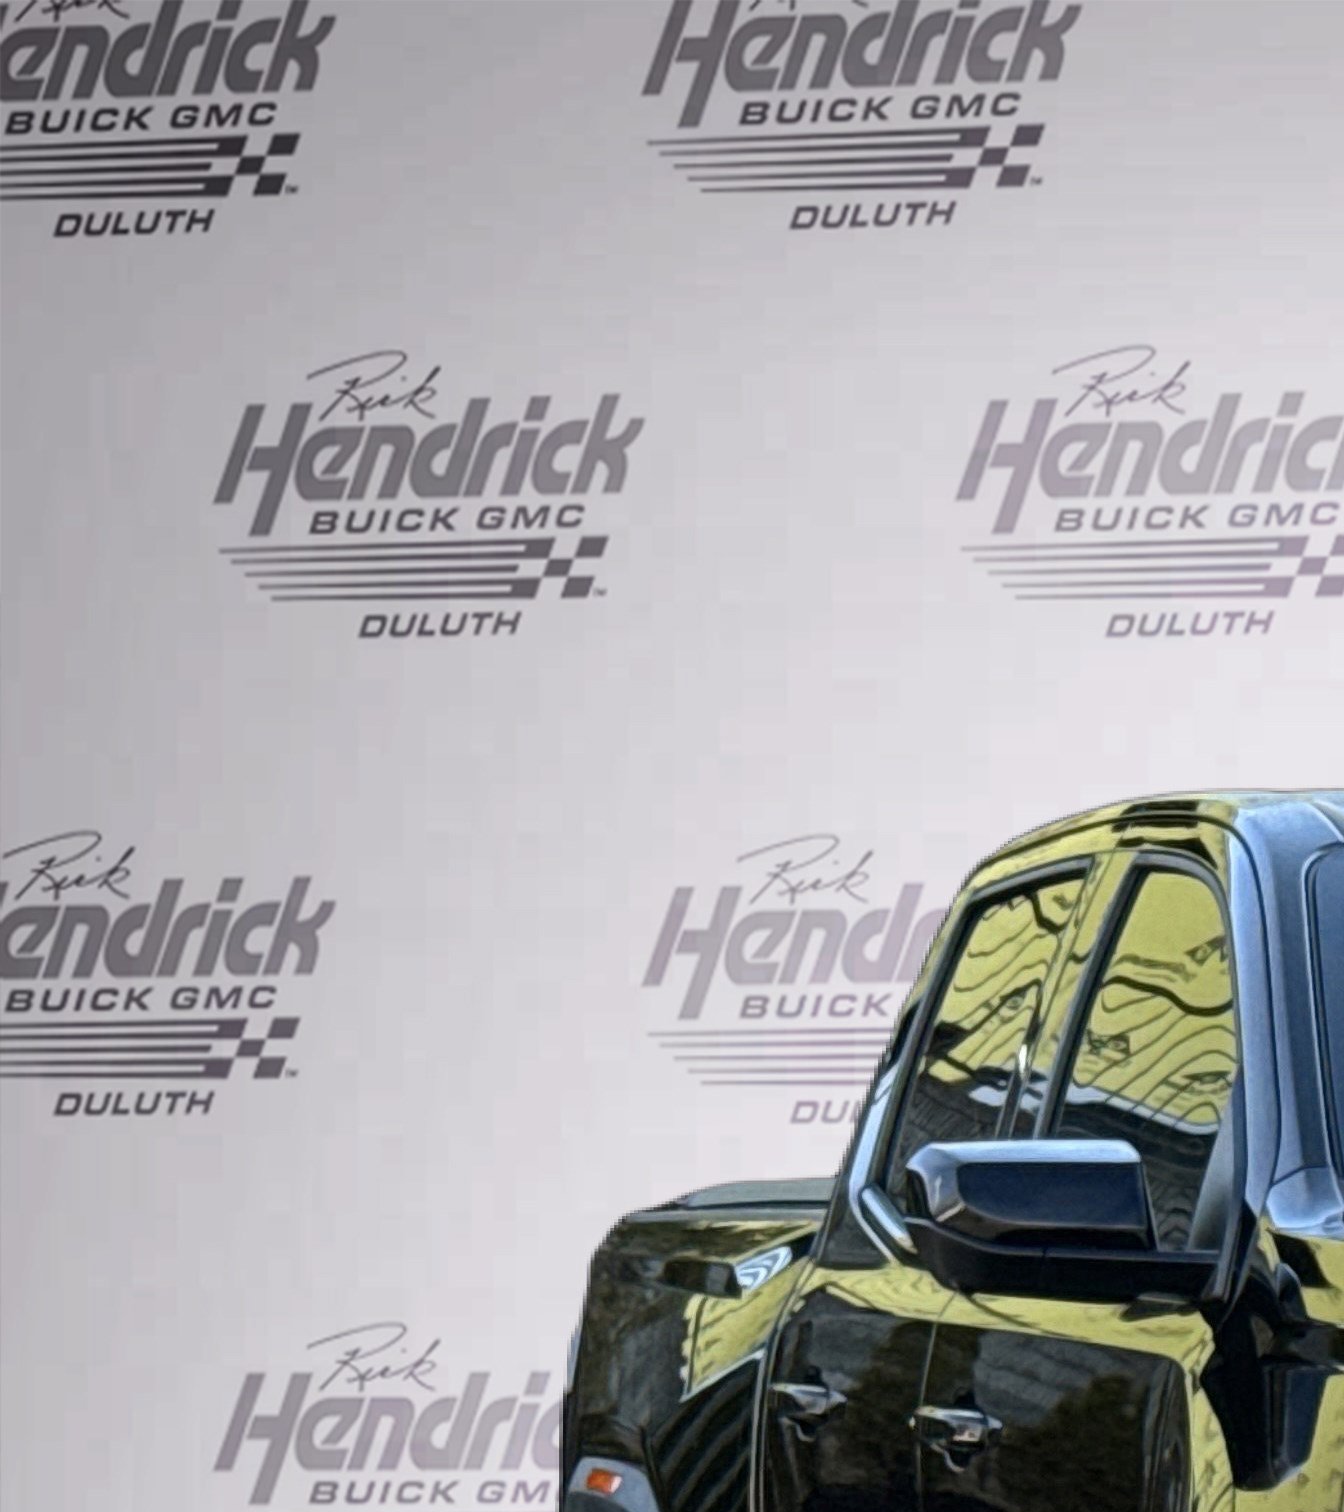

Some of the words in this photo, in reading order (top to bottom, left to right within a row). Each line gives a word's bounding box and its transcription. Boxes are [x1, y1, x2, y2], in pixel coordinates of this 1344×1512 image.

[0, 0, 336, 103] endrick
[642, 0, 1082, 128] Hendrick
[5, 106, 153, 135] BUICK
[170, 102, 277, 129] GMC
[739, 97, 892, 126] BUICK
[910, 92, 1021, 119] GMC
[54, 209, 215, 237] DULUTH
[790, 201, 956, 230] DULUTH
[213, 394, 644, 537] Hendrick
[309, 508, 458, 534] BUICK
[476, 504, 585, 530] GMC
[1054, 505, 1209, 532] BUICK
[1228, 502, 1340, 528] GMC
[358, 612, 521, 638] DULUTH
[1106, 611, 1274, 638] DULUTH
[0, 876, 335, 981] endrick
[641, 882, 948, 1020] Hendr
[5, 987, 152, 1013] BUICK
[170, 986, 276, 1010] GMC
[739, 994, 891, 1019] BUICK
[54, 1091, 214, 1116] DULUTH
[213, 1371, 561, 1506] Hendri
[309, 1481, 458, 1505] BUICK
[476, 1481, 560, 1504] GM
